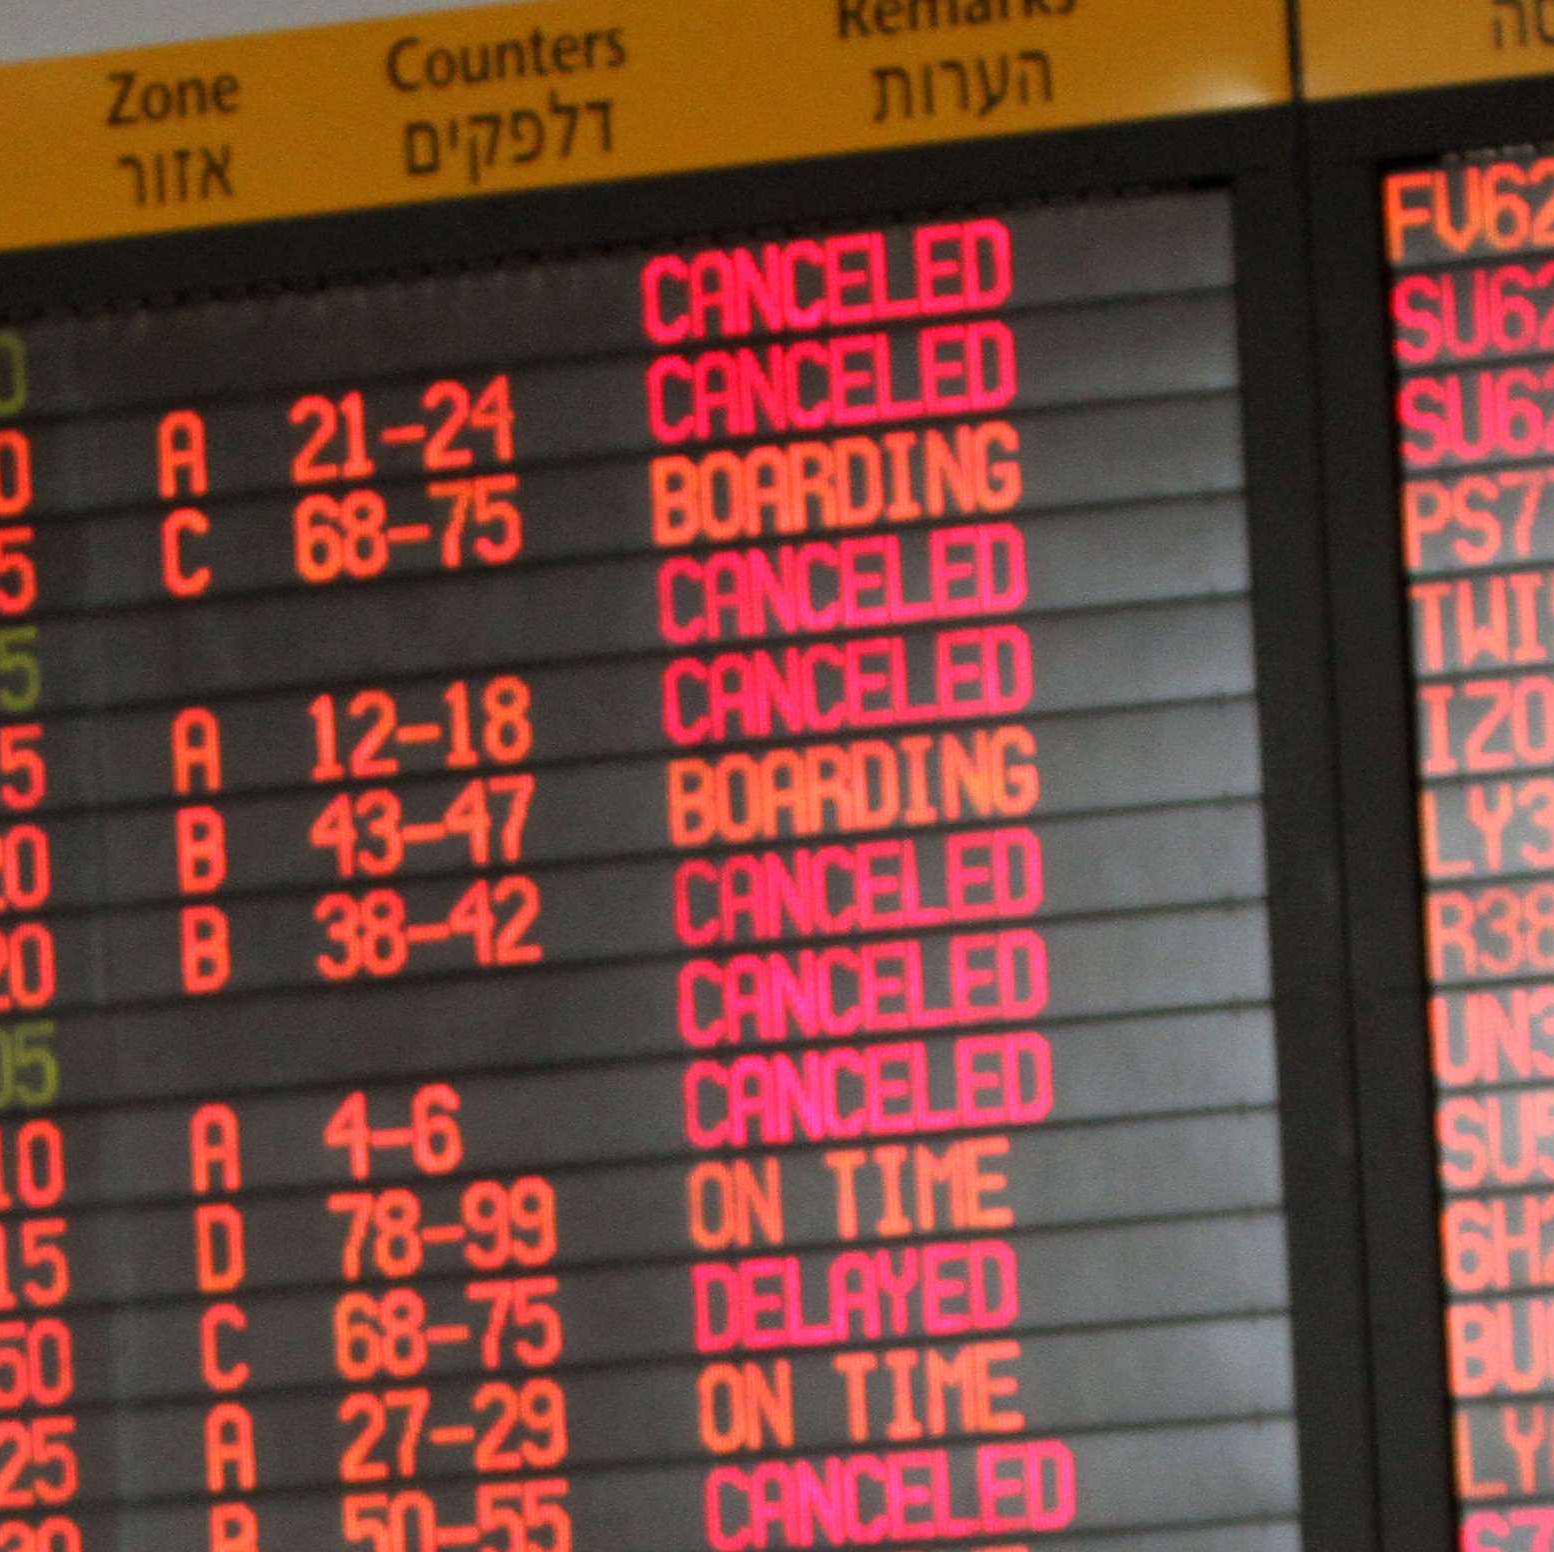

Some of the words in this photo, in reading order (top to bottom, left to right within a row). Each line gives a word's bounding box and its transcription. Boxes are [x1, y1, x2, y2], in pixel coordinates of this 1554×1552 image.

[106, 70, 240, 128] Zone
[384, 27, 627, 93] Counters
[871, 49, 1053, 124] הערות
[117, 145, 234, 205] אזור
[403, 90, 614, 186] דלפקים
[640, 216, 1015, 347] CANCELED
[158, 409, 210, 499] A
[289, 373, 517, 485] 21-24
[645, 318, 1020, 446] CANCELED
[161, 506, 214, 598] C
[294, 472, 525, 583] 68-75
[650, 419, 1024, 547] BOARDING
[309, 675, 534, 782] 12-18
[662, 623, 1035, 747] CANCELED
[176, 804, 229, 895] B
[310, 773, 537, 878] 43-47
[668, 724, 1041, 847] BOARDING
[314, 874, 544, 980] 38-42
[190, 1102, 243, 1194] A
[324, 1082, 466, 1181] 4-6
[682, 1030, 1055, 1150] CANCELED
[195, 1202, 247, 1293] D
[327, 1175, 559, 1281] 78-99
[688, 1156, 786, 1250] ON
[825, 1135, 1015, 1240] TIME
[690, 1238, 1021, 1354] DELAYED
[205, 1401, 258, 1494] A
[339, 1377, 570, 1483] 27-29
[698, 1358, 796, 1454] ON
[834, 1339, 1027, 1442] TIME
